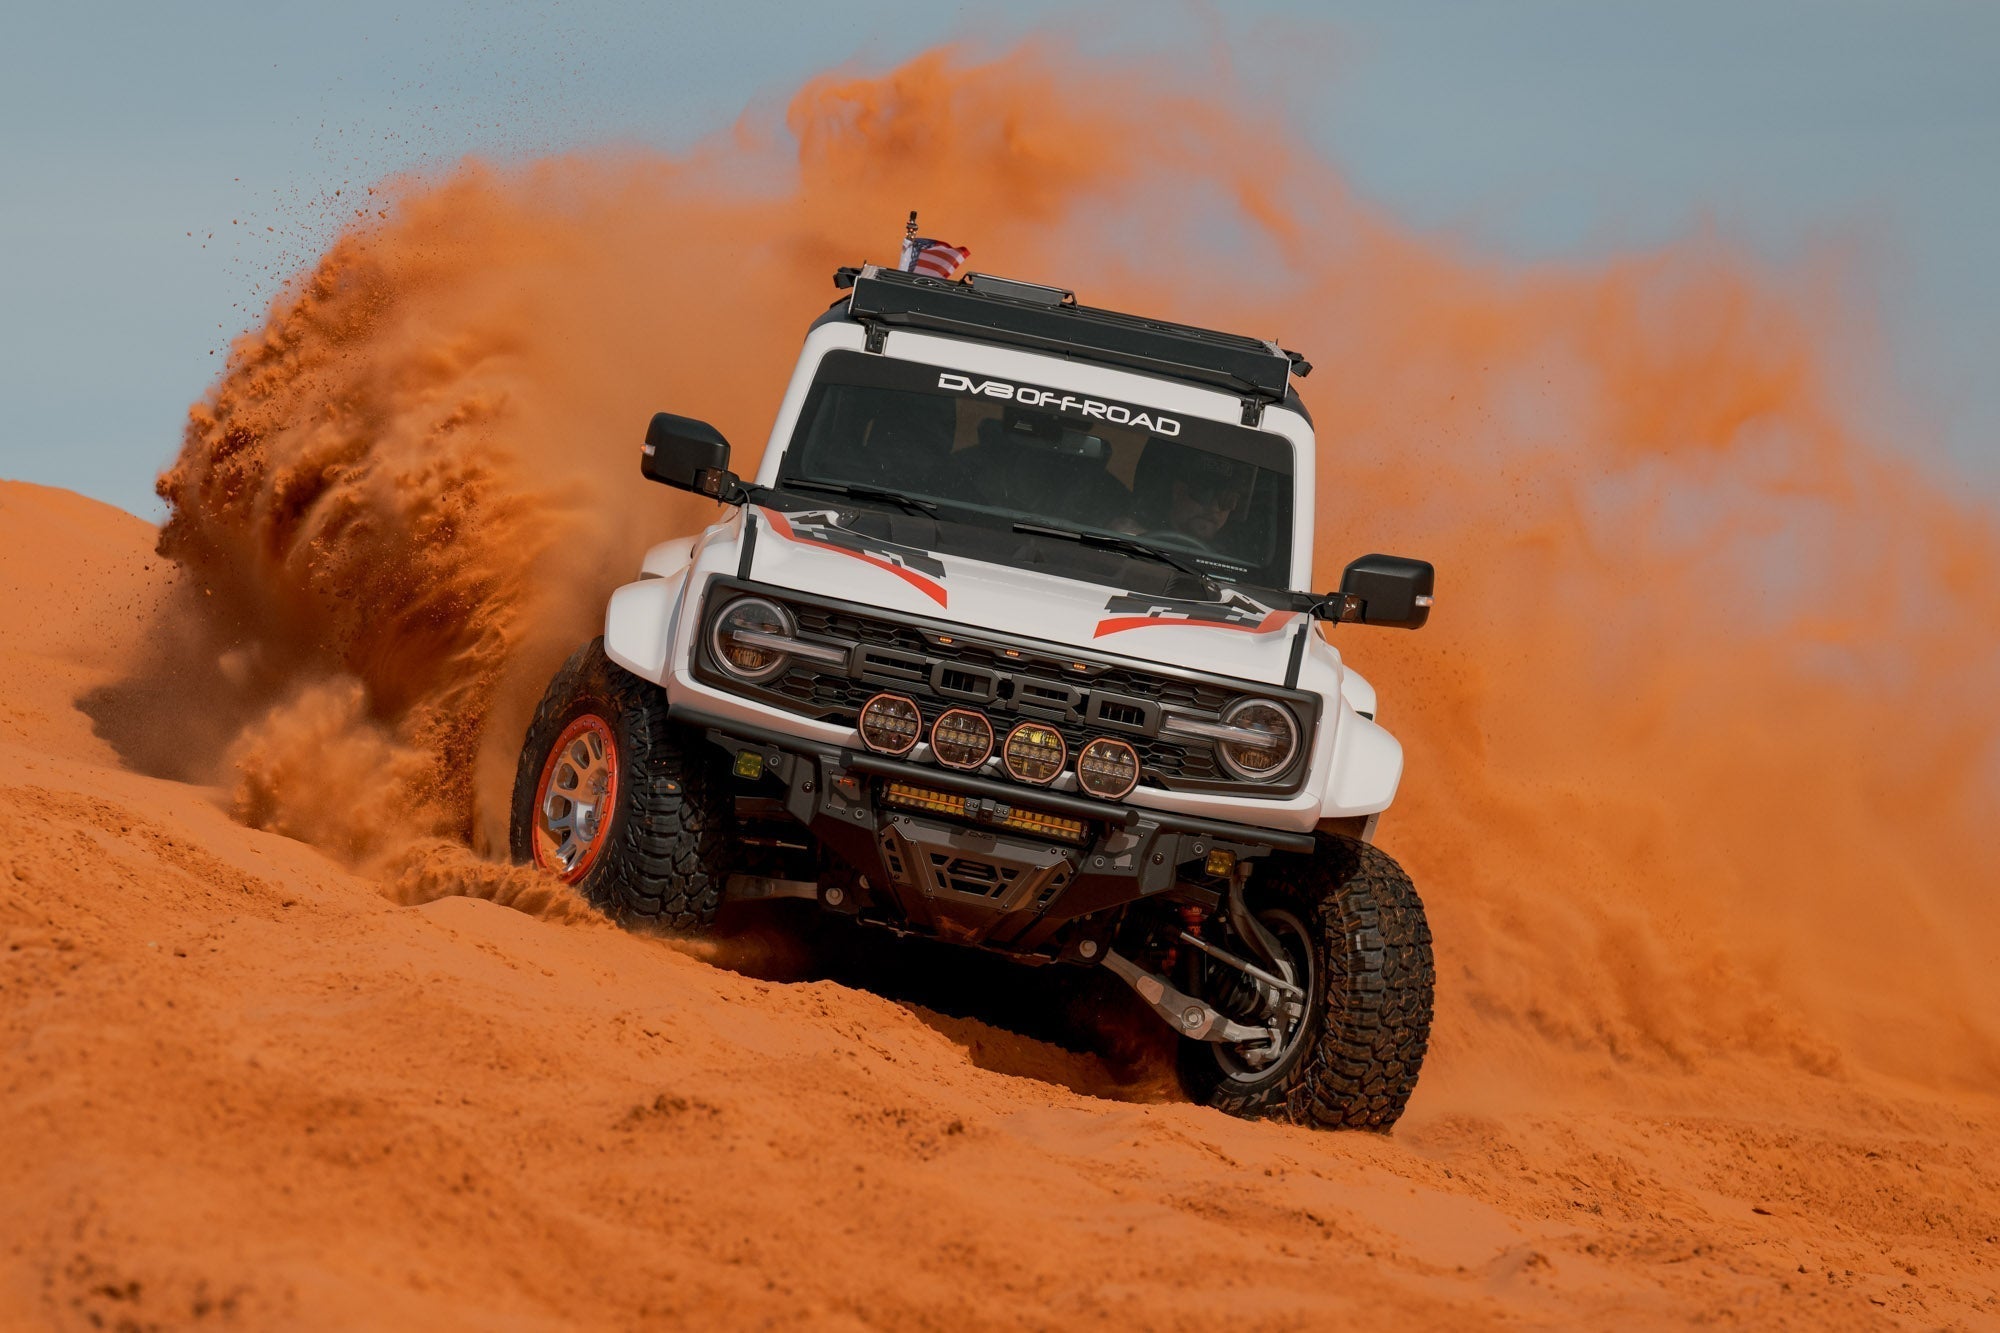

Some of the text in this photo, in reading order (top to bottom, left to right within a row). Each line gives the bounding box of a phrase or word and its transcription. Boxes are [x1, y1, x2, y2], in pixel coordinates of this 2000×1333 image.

[938, 373, 1180, 437] DV8 OFFROAD
[850, 643, 1160, 737] FORD
